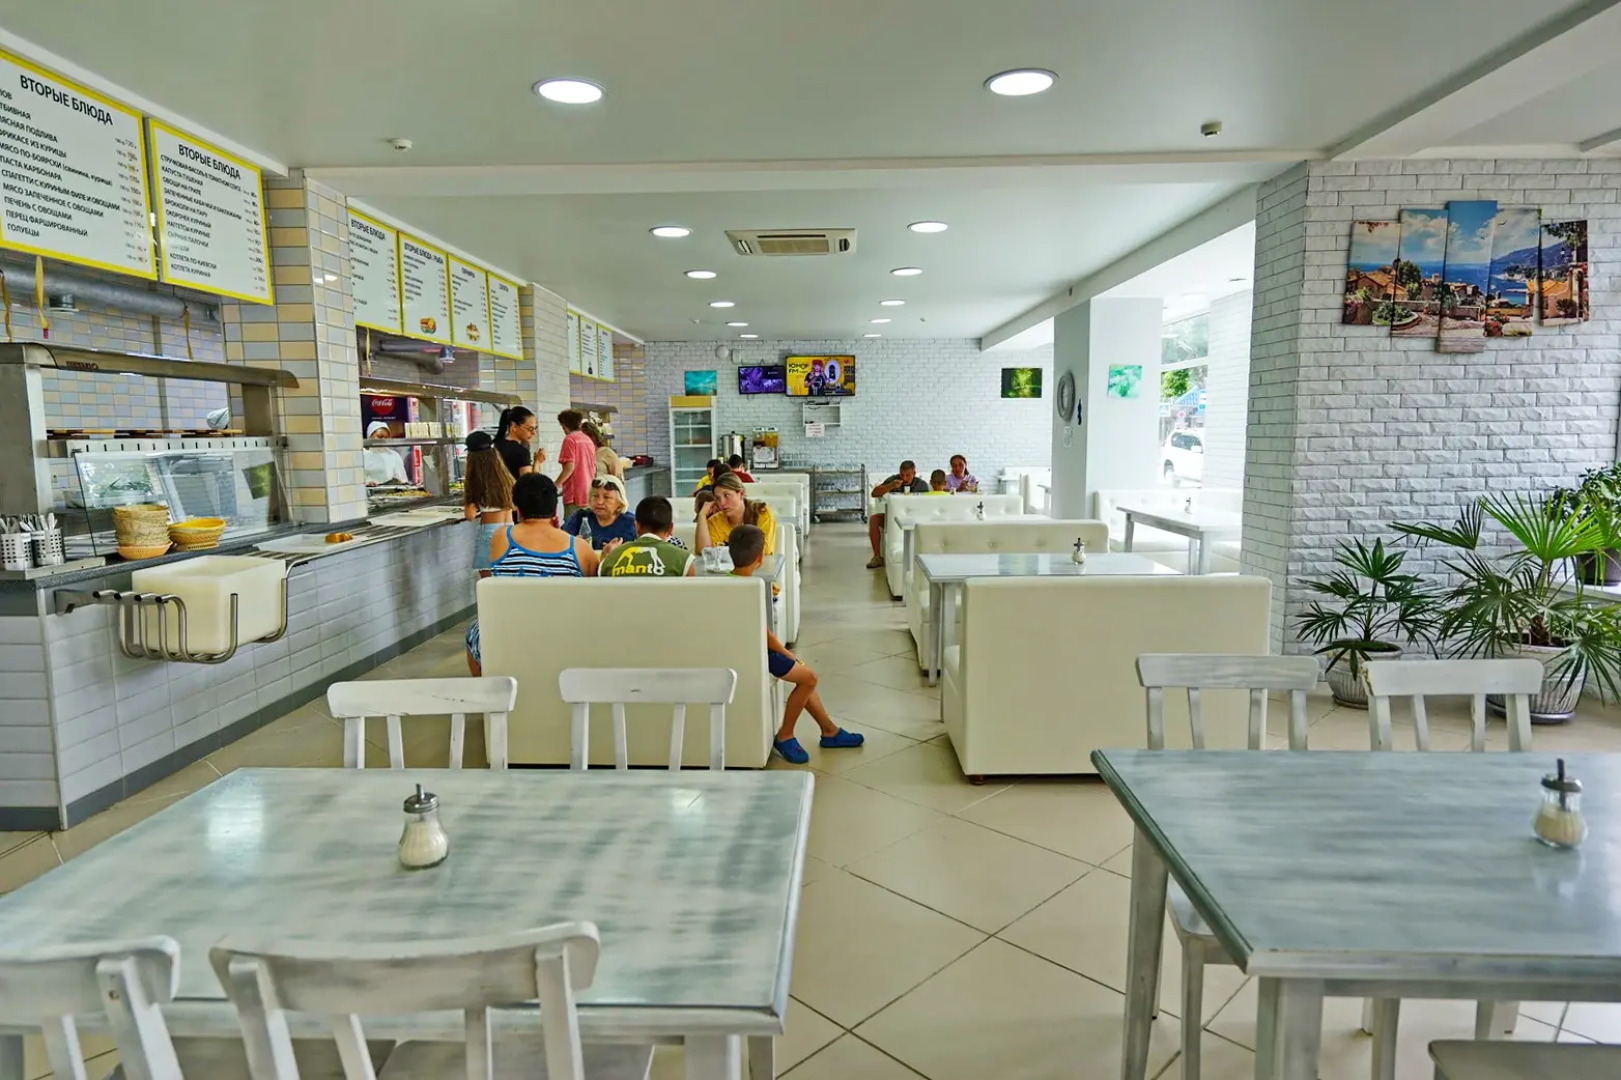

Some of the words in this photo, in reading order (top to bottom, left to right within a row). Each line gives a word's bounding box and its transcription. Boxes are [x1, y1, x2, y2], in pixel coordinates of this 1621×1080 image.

[20, 75, 70, 107] ВТОРЫЕ
[72, 98, 113, 125] БЛЮДА
[0, 116, 24, 131] ЯСНАЯ
[29, 139, 39, 149] ИЗ
[39, 142, 67, 158] КУРИЦЫ
[0, 155, 23, 169] ПАСТА
[23, 162, 62, 181] КАРБОНАРА
[178, 144, 212, 168] ВТОРЫЕ
[212, 160, 241, 180] БЛЮДА
[1, 168, 34, 185] СПАГЕТТИ
[39, 180, 70, 196] КУРИНЫМ
[90, 195, 120, 211] ОВОЩАМИ
[2, 182, 23, 195] МЯСО
[24, 188, 66, 207] ЗАПЕЧЕННОЕ
[72, 202, 104, 218] ОВОЩАМИ
[3, 195, 31, 210] ПЕЧЕНЬ
[31, 203, 37, 211] С
[37, 204, 72, 221] ОВОЩАМИ
[5, 208, 28, 222] ПЕРЕЦ
[28, 214, 88, 237] ФАРШИРОВАННЫЙ
[6, 222, 40, 237] ГОЛУБЦЫ
[351, 219, 370, 234] ВТОРЫЕ
[612, 562, 666, 577] manto
